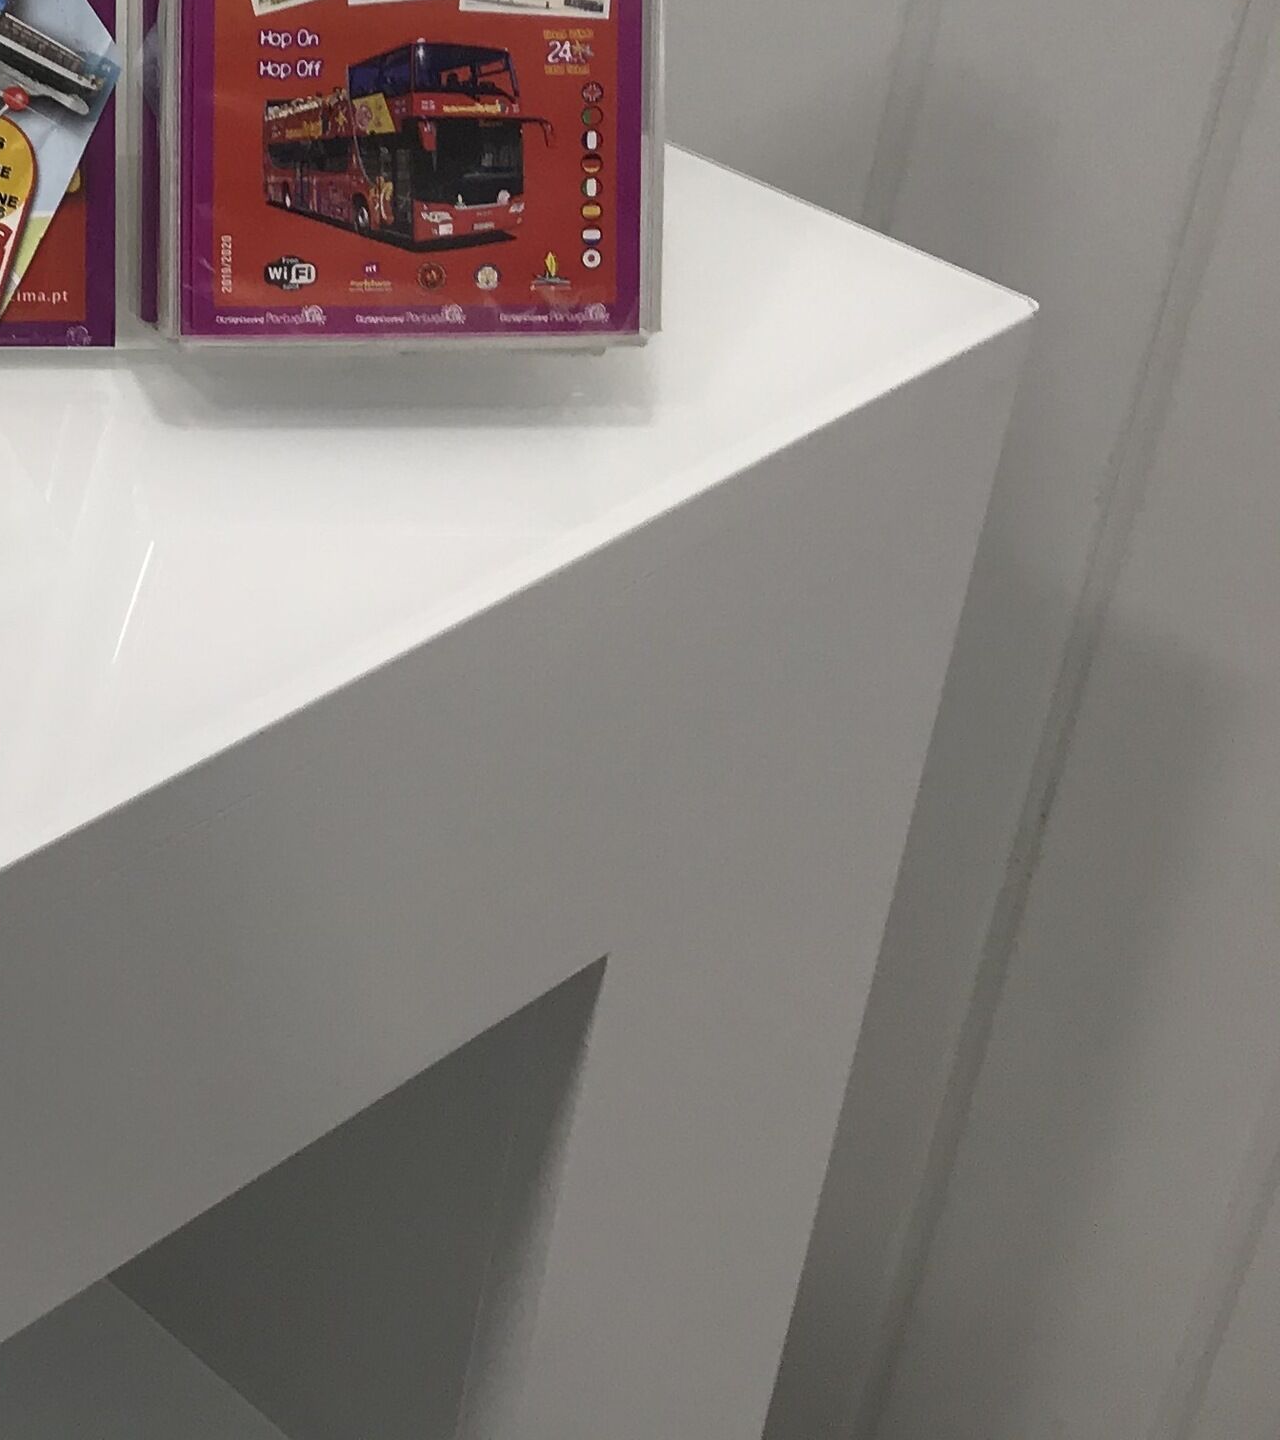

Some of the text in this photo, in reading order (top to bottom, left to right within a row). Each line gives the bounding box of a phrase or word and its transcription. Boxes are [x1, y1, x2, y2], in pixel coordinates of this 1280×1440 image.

[260, 28, 319, 49] Hop On
[260, 59, 322, 79] Hop Off
[15, 289, 69, 305] ima.pt
